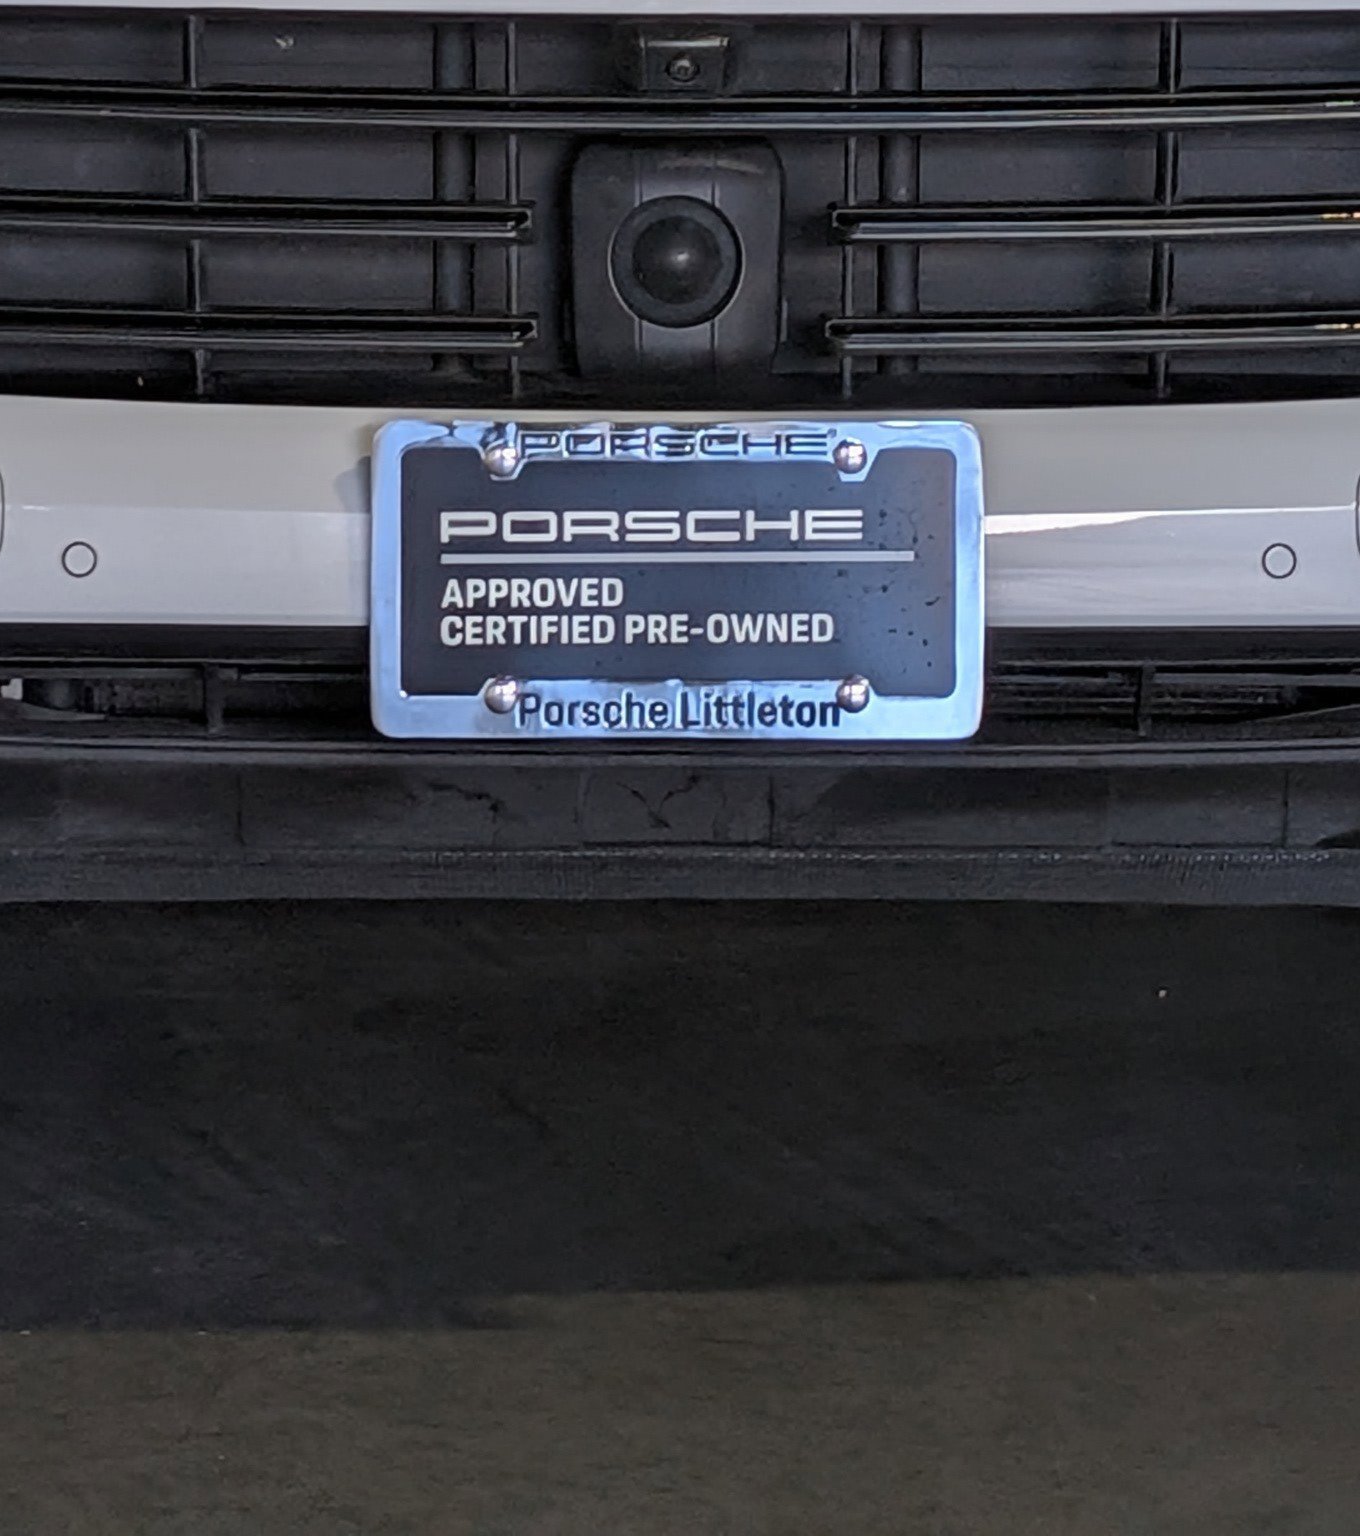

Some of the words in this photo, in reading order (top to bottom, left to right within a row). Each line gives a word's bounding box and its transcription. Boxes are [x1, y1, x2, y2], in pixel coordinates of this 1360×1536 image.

[520, 430, 827, 457] PORSCHE
[441, 510, 864, 544] PORSCHE
[442, 577, 624, 608] APPROVED
[441, 614, 616, 646] CERTIFIED
[625, 613, 835, 645] PRE-OWNED
[519, 691, 669, 727] Porsche
[680, 690, 841, 727] Littleton
